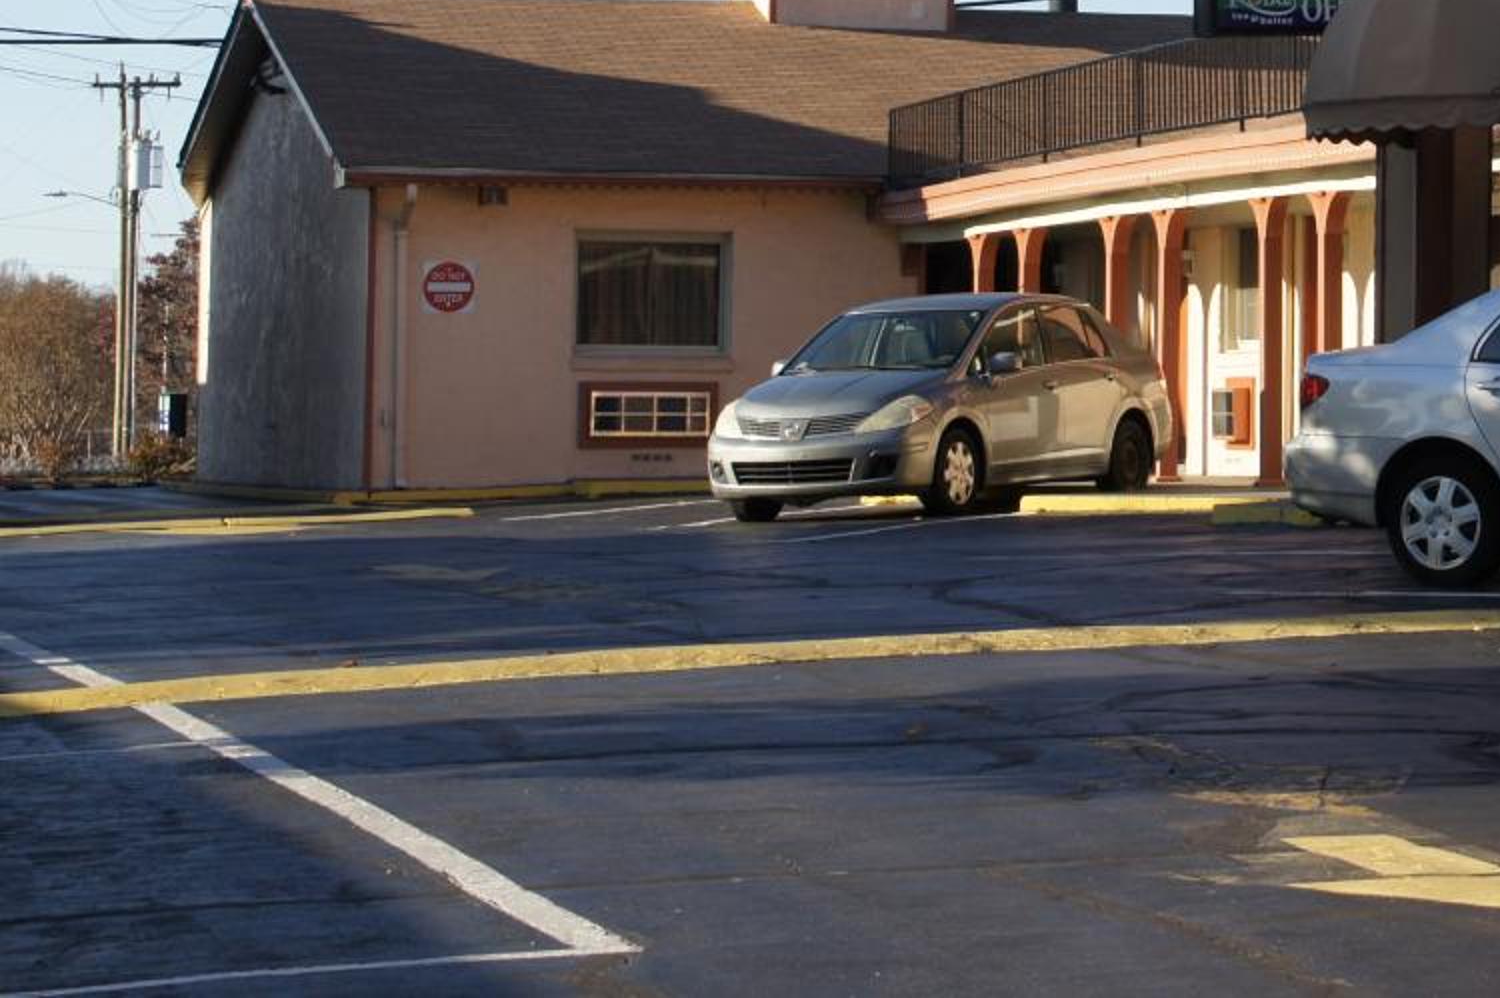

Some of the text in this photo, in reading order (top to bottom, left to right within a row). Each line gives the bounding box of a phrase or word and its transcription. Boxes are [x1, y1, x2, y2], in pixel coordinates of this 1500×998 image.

[431, 271, 465, 281] DO NOT
[433, 293, 463, 303] ENTER
